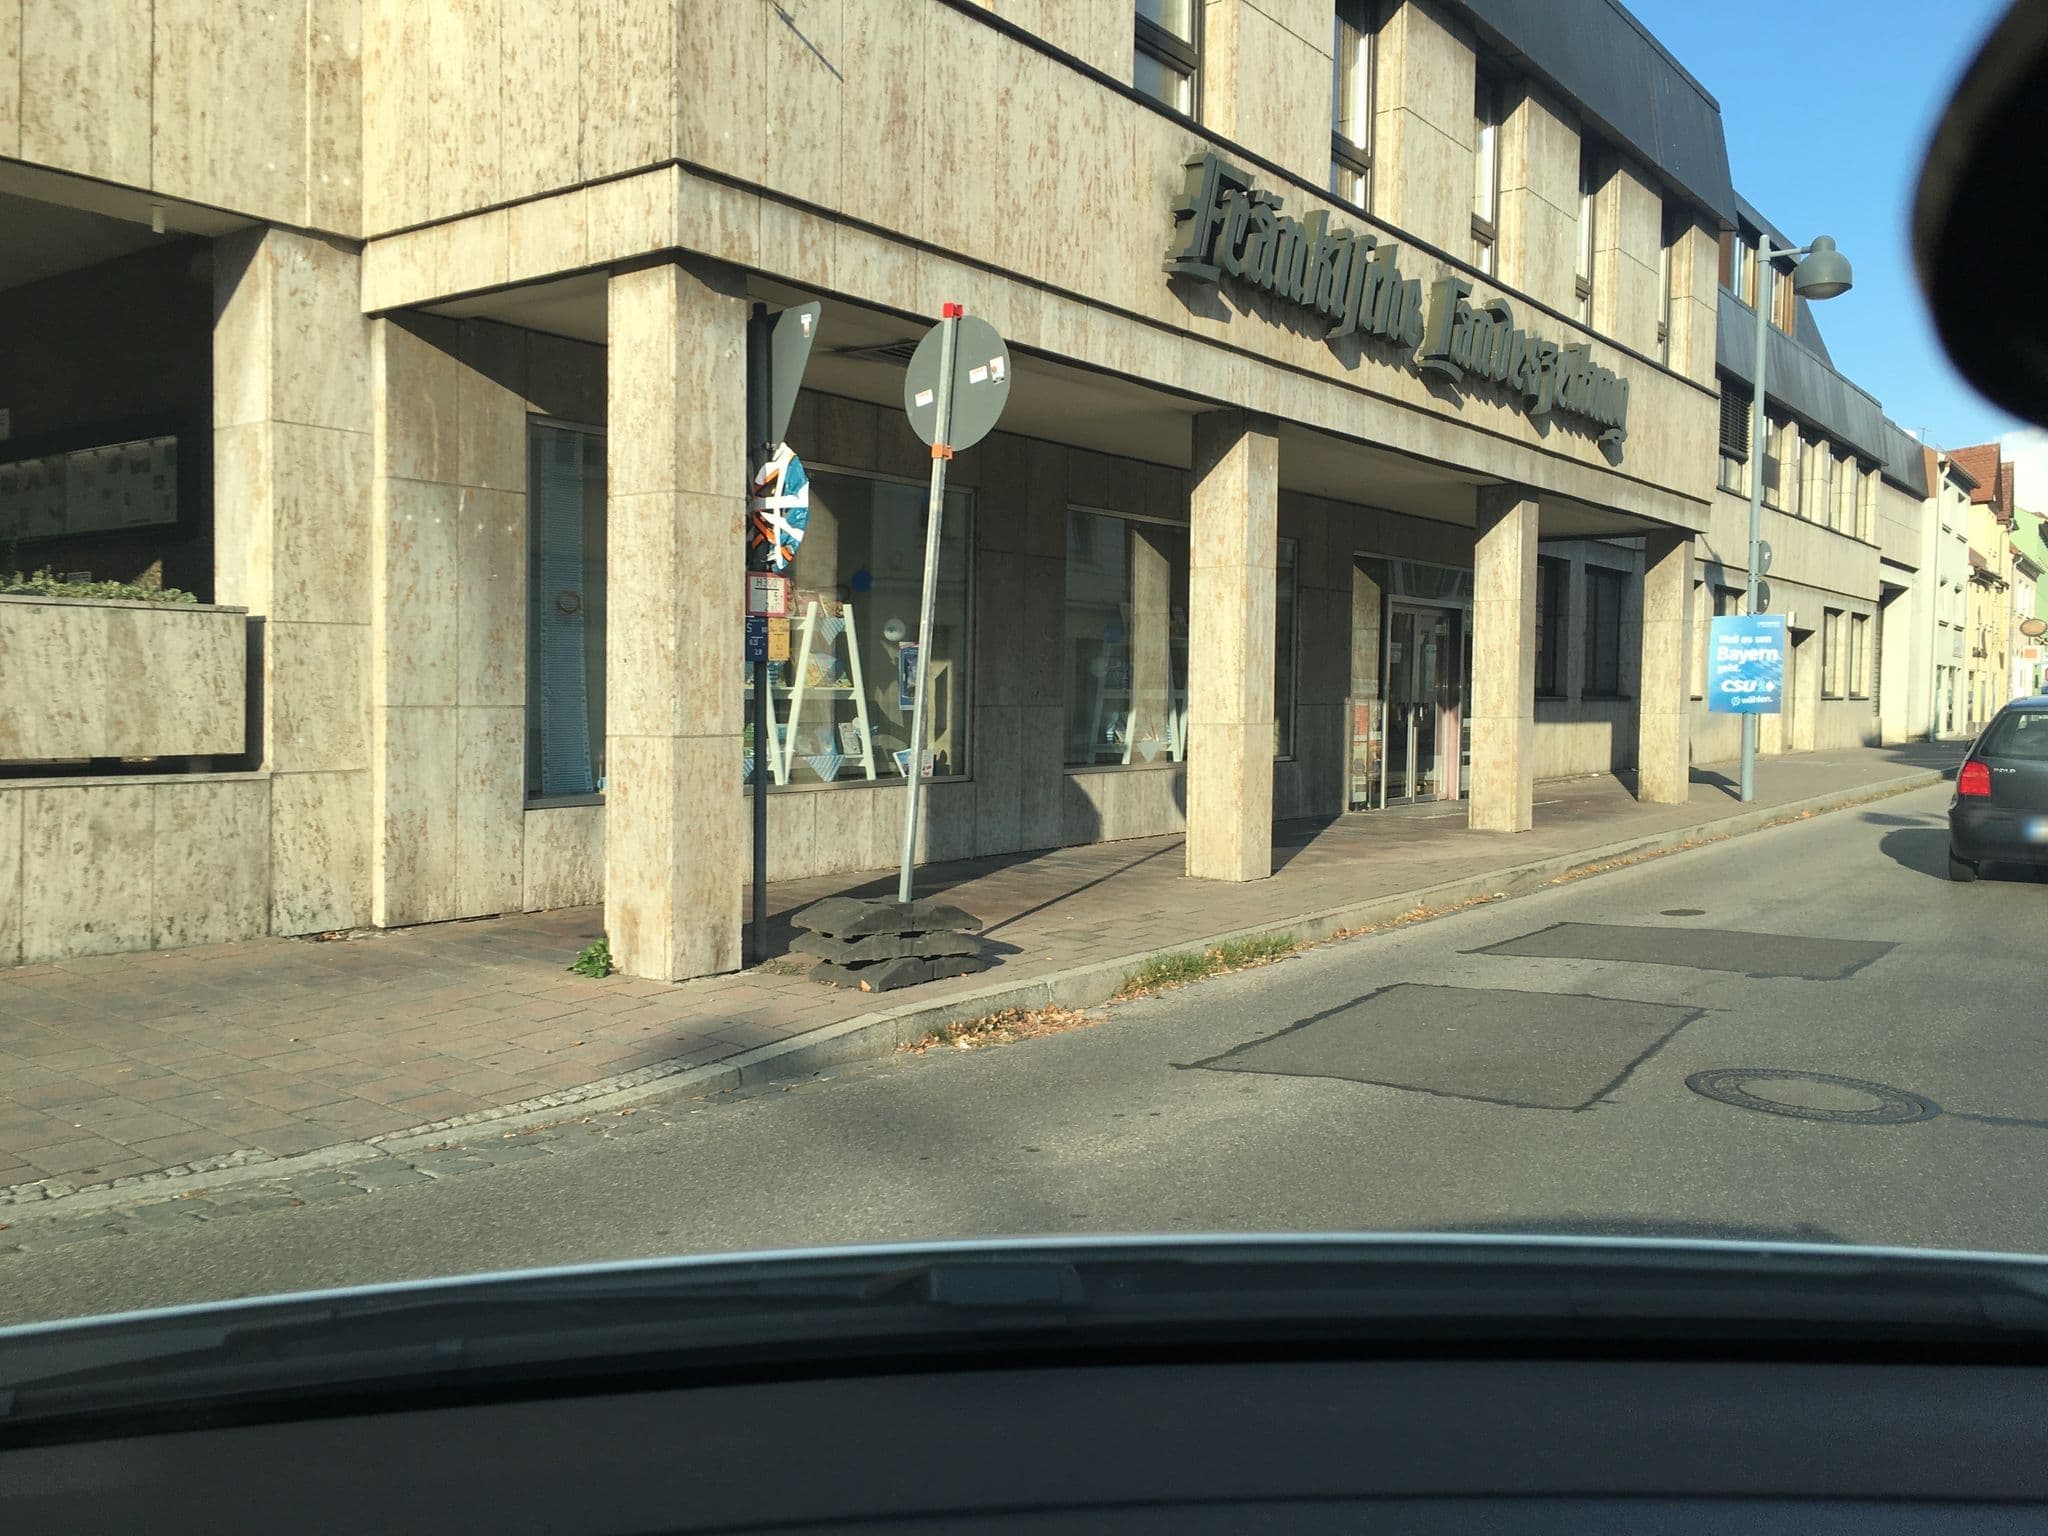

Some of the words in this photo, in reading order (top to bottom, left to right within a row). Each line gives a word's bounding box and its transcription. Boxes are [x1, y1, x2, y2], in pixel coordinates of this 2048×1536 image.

[1417, 275, 1630, 452] Landeszeitung
[1717, 645, 1778, 664] Bayern
[1721, 679, 1758, 692] CSU
